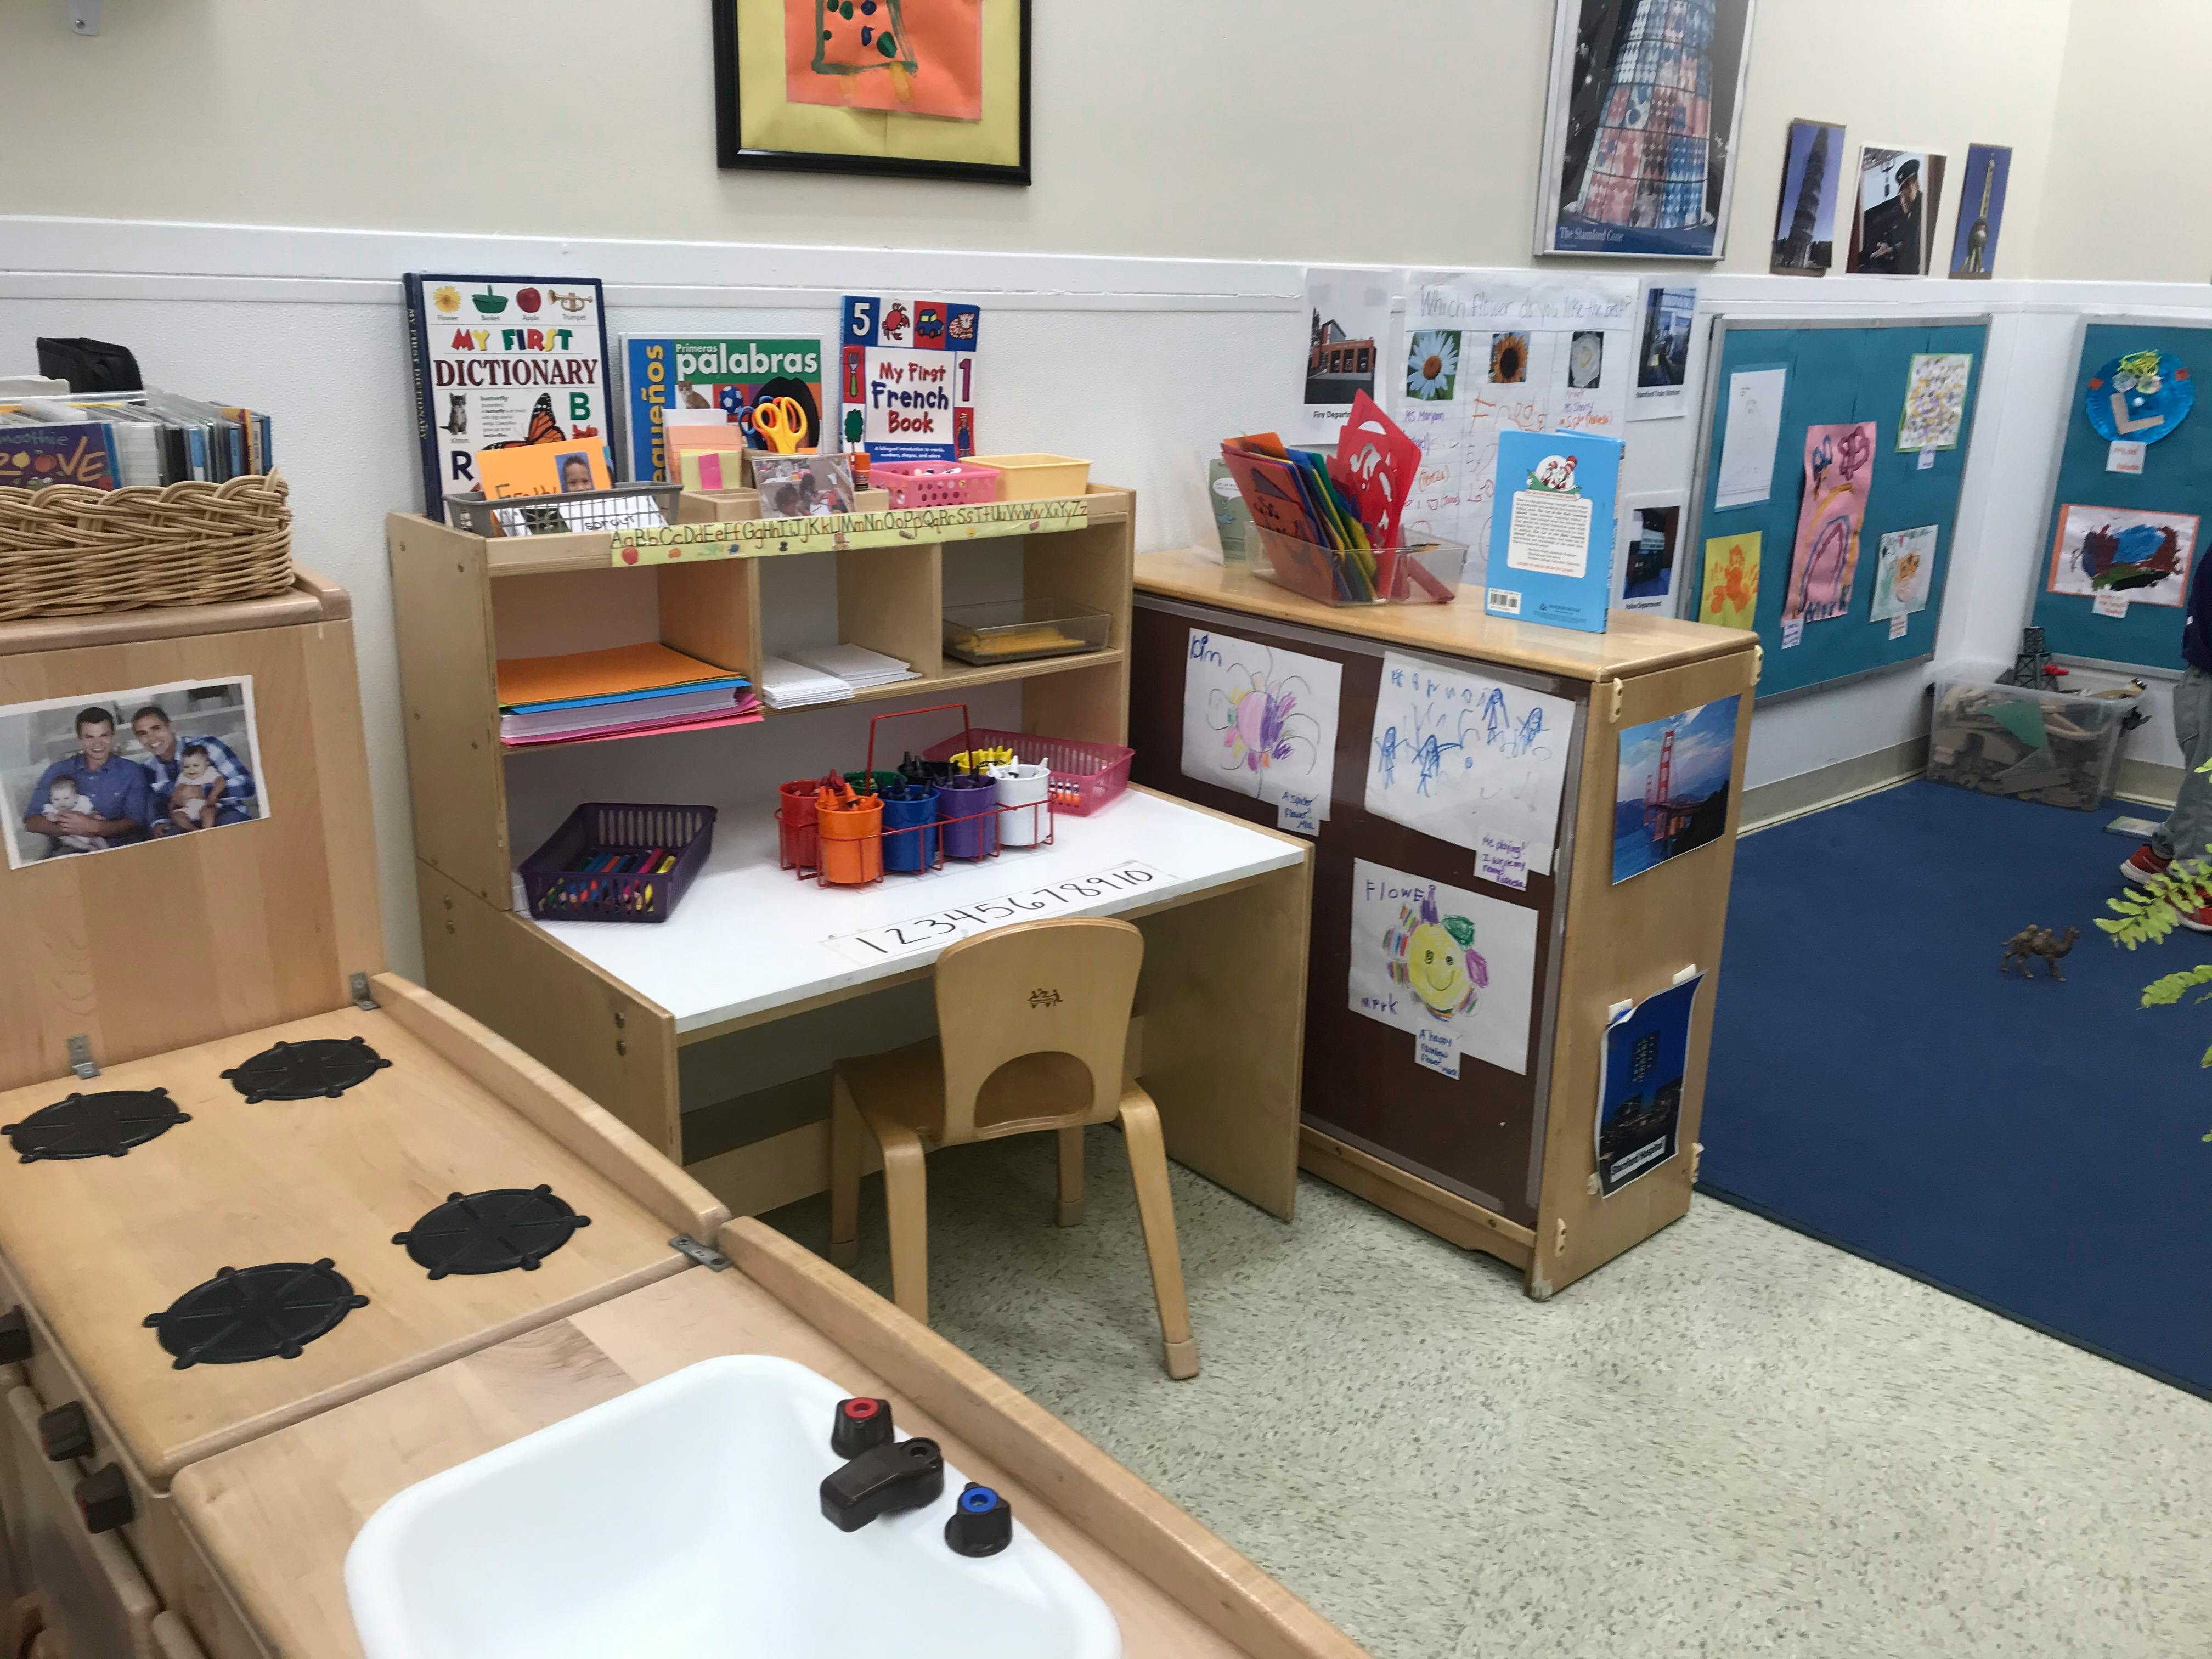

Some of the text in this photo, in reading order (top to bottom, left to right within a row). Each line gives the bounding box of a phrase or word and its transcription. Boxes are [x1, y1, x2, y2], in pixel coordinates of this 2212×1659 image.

[852, 302, 871, 336] 5
[451, 328, 573, 352] MY FIRST
[675, 343, 718, 353] Primeras
[433, 358, 598, 387] DICTIONARY
[676, 342, 818, 382] palabras
[878, 360, 947, 383] My First
[870, 380, 949, 410] French
[958, 358, 972, 402] 1
[569, 391, 591, 421] B
[887, 409, 934, 434] Book
[450, 450, 475, 482] R
